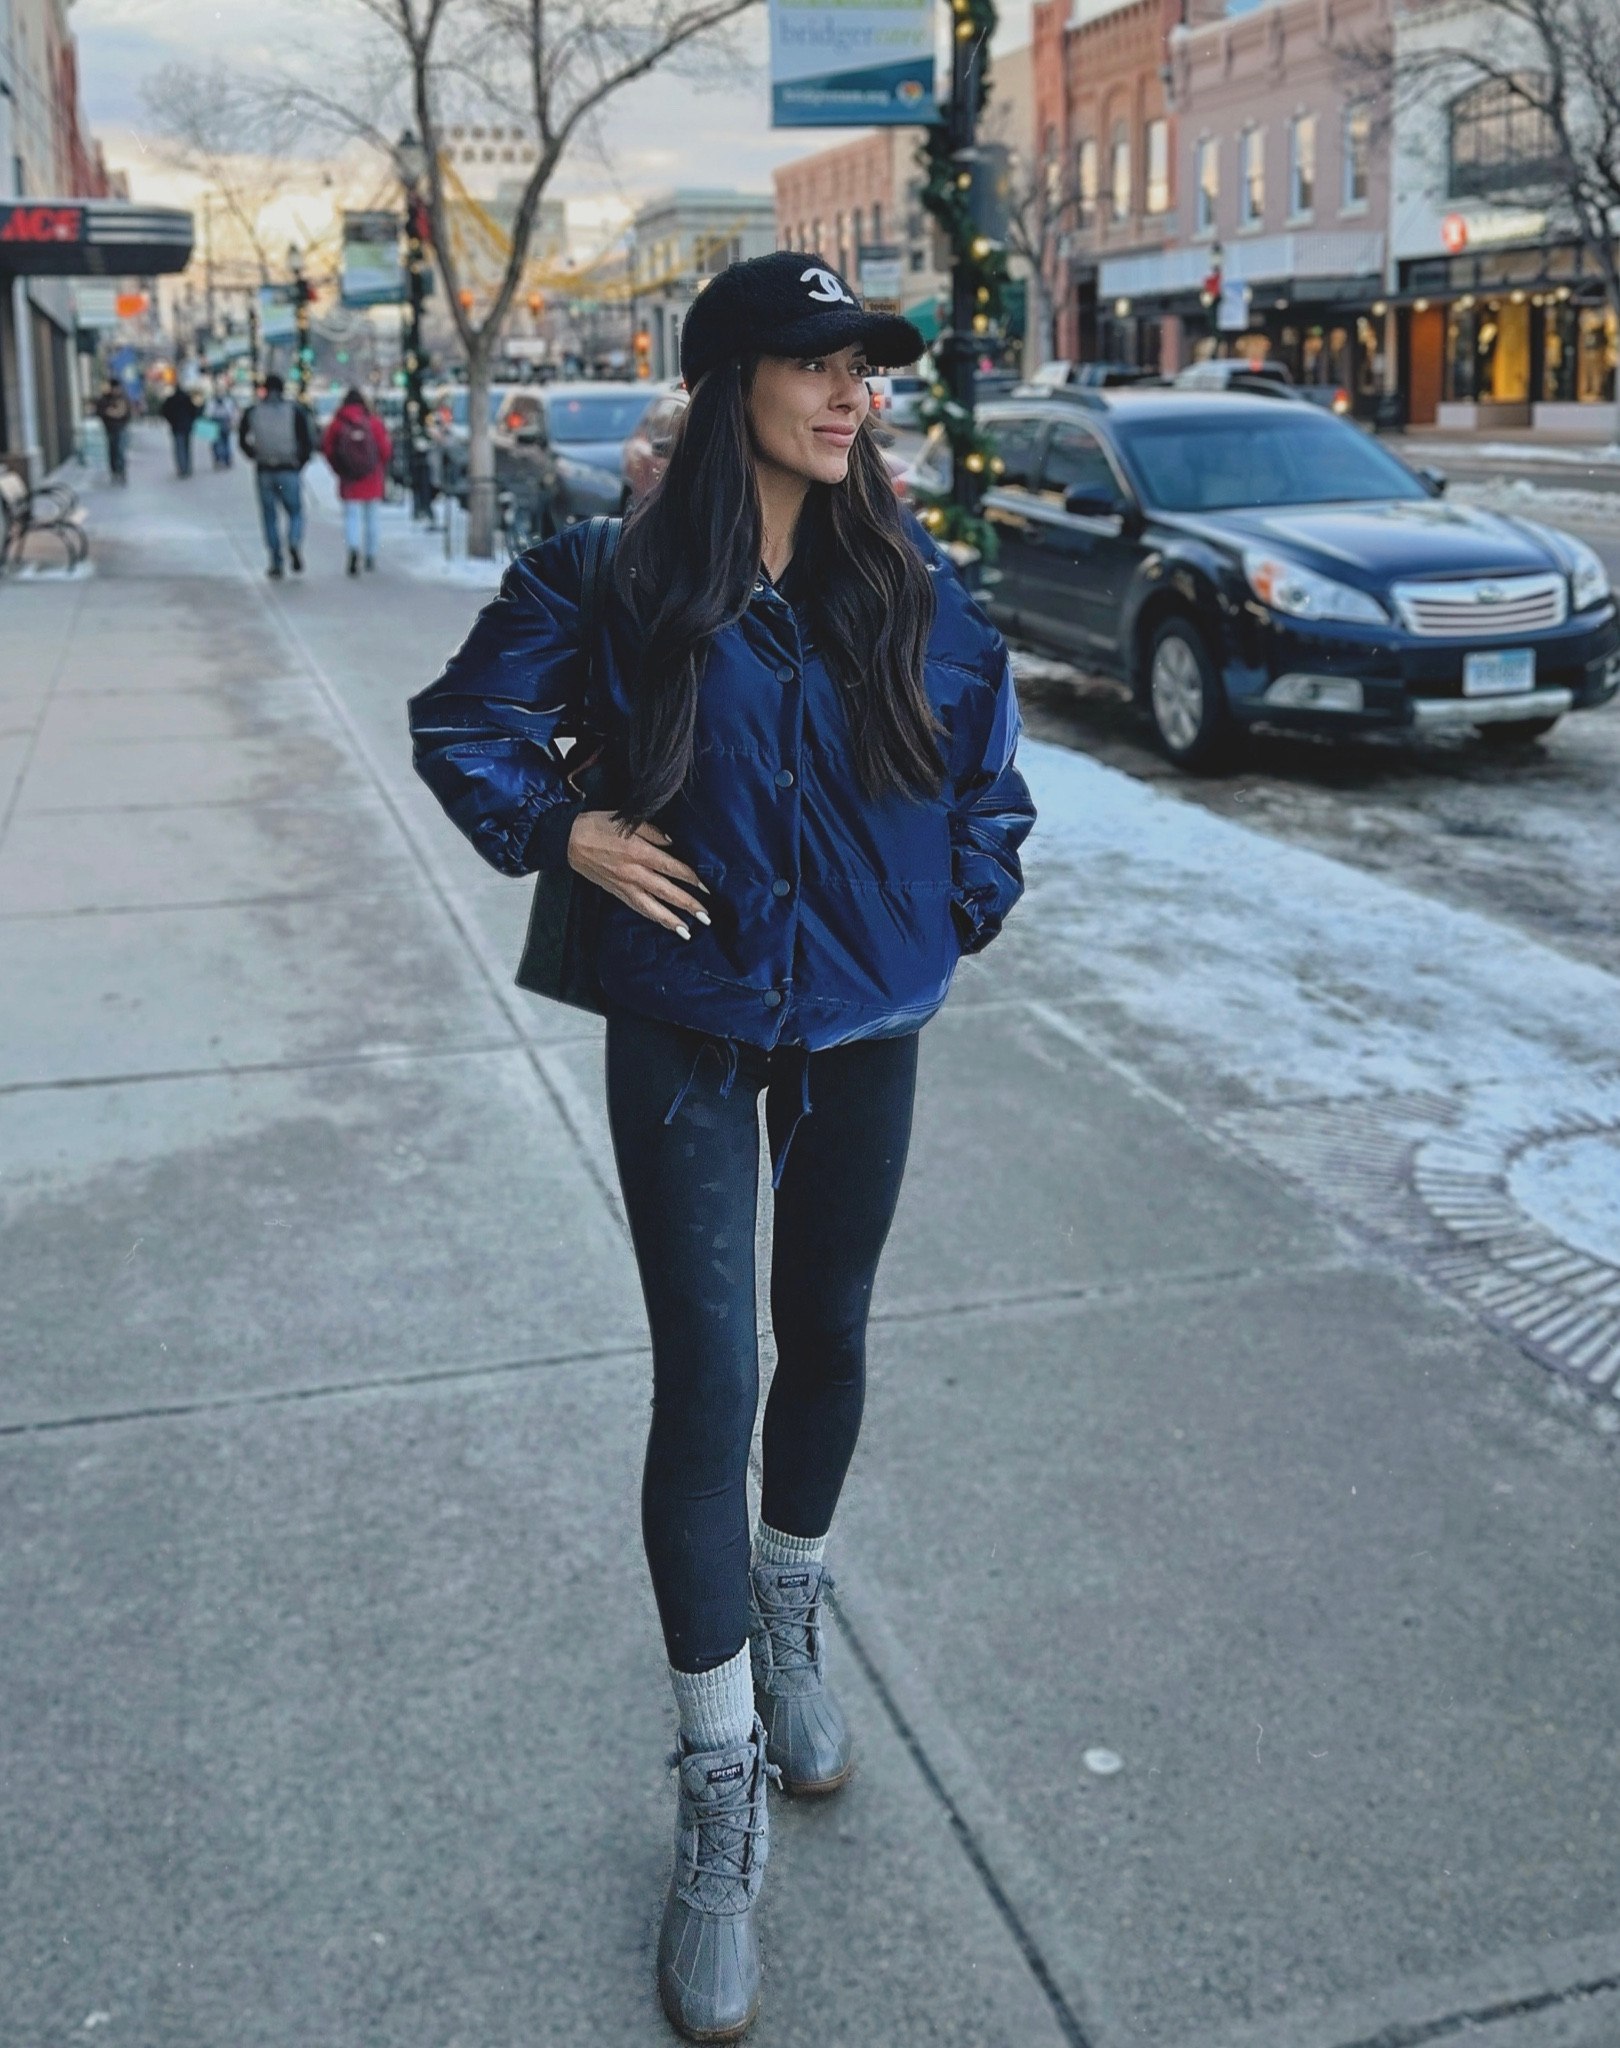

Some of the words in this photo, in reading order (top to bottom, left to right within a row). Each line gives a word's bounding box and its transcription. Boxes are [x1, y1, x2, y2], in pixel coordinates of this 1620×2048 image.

[1, 206, 81, 241] ACE
[781, 1575, 808, 1585] SPERRY
[711, 1765, 741, 1779] SPERRY
